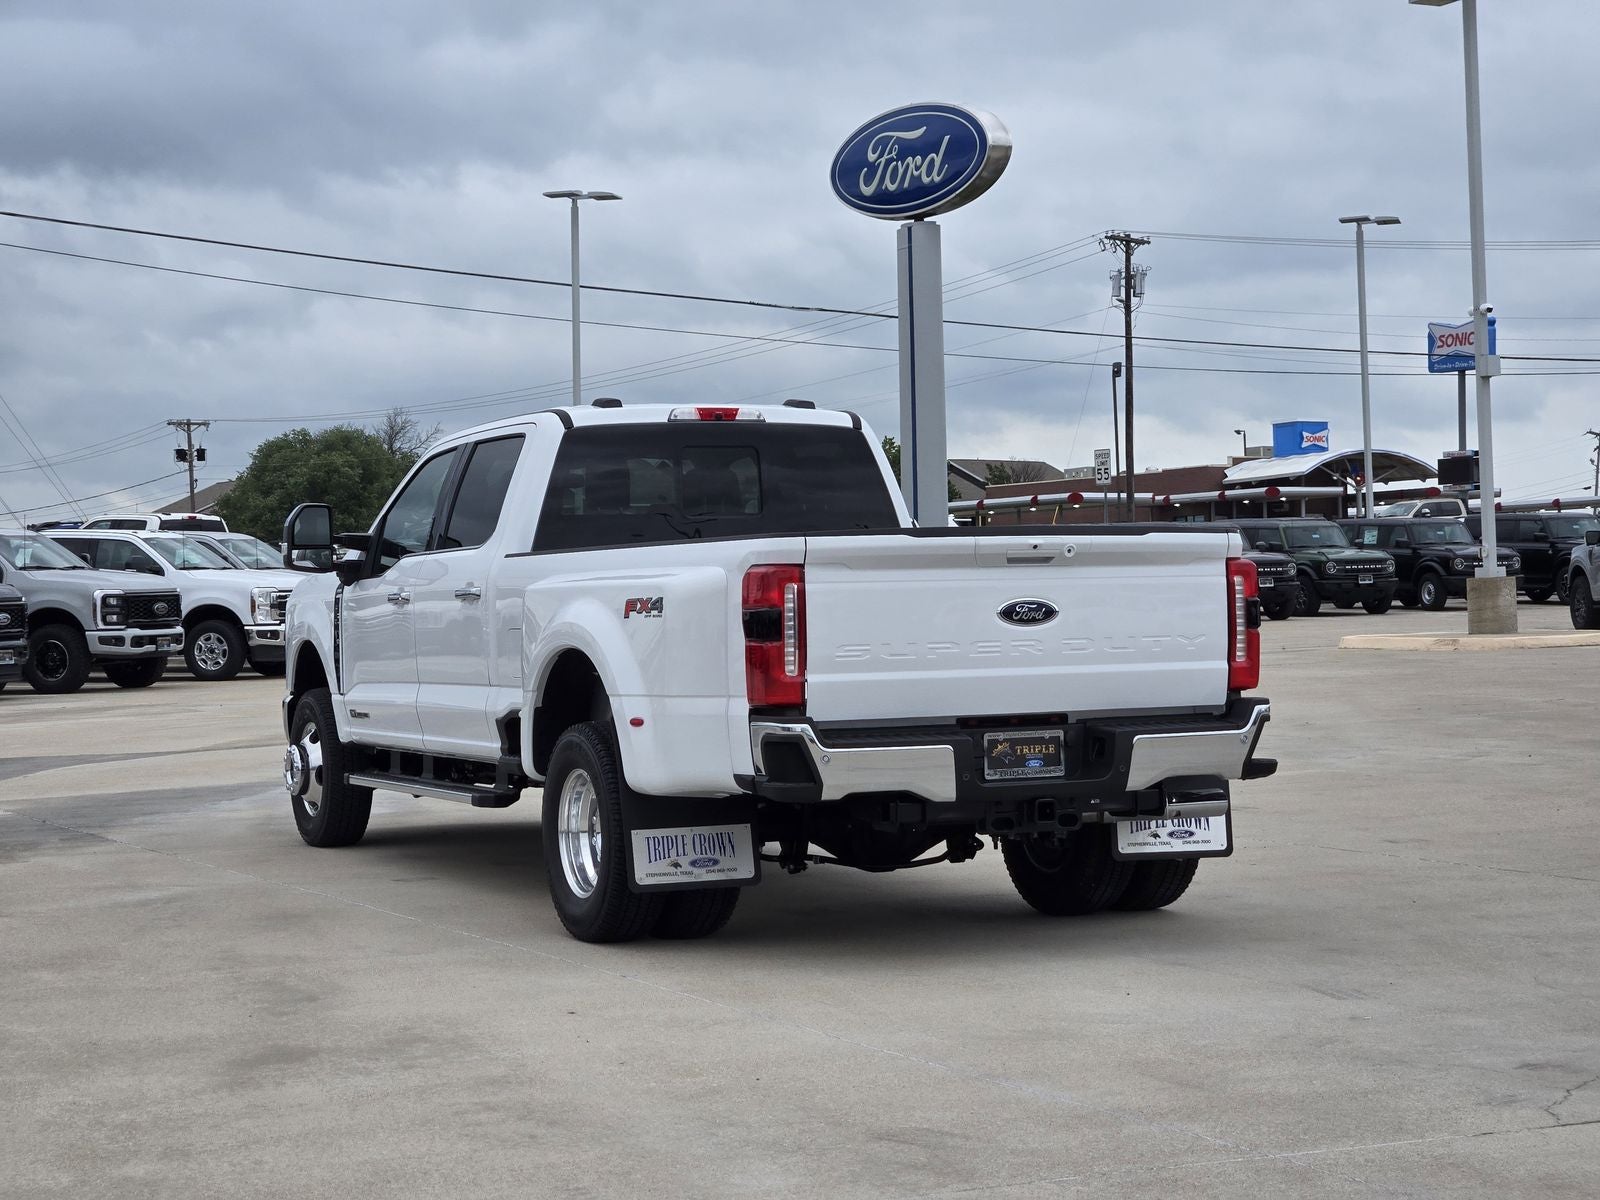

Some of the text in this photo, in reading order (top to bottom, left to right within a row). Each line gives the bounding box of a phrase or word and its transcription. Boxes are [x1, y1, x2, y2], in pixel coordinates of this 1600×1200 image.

[859, 126, 951, 196] Ford
[1437, 331, 1475, 349] SONIC
[1305, 435, 1325, 443] SONIC
[1095, 452, 1110, 460] SPEED
[1097, 467, 1110, 481] 55
[624, 597, 664, 619] FX4
[1012, 603, 1046, 620] Ford
[834, 633, 1206, 661] SUPER DUTY
[1015, 744, 1056, 755] TRIPLE
[644, 831, 736, 864] TRIPLE CROWN
